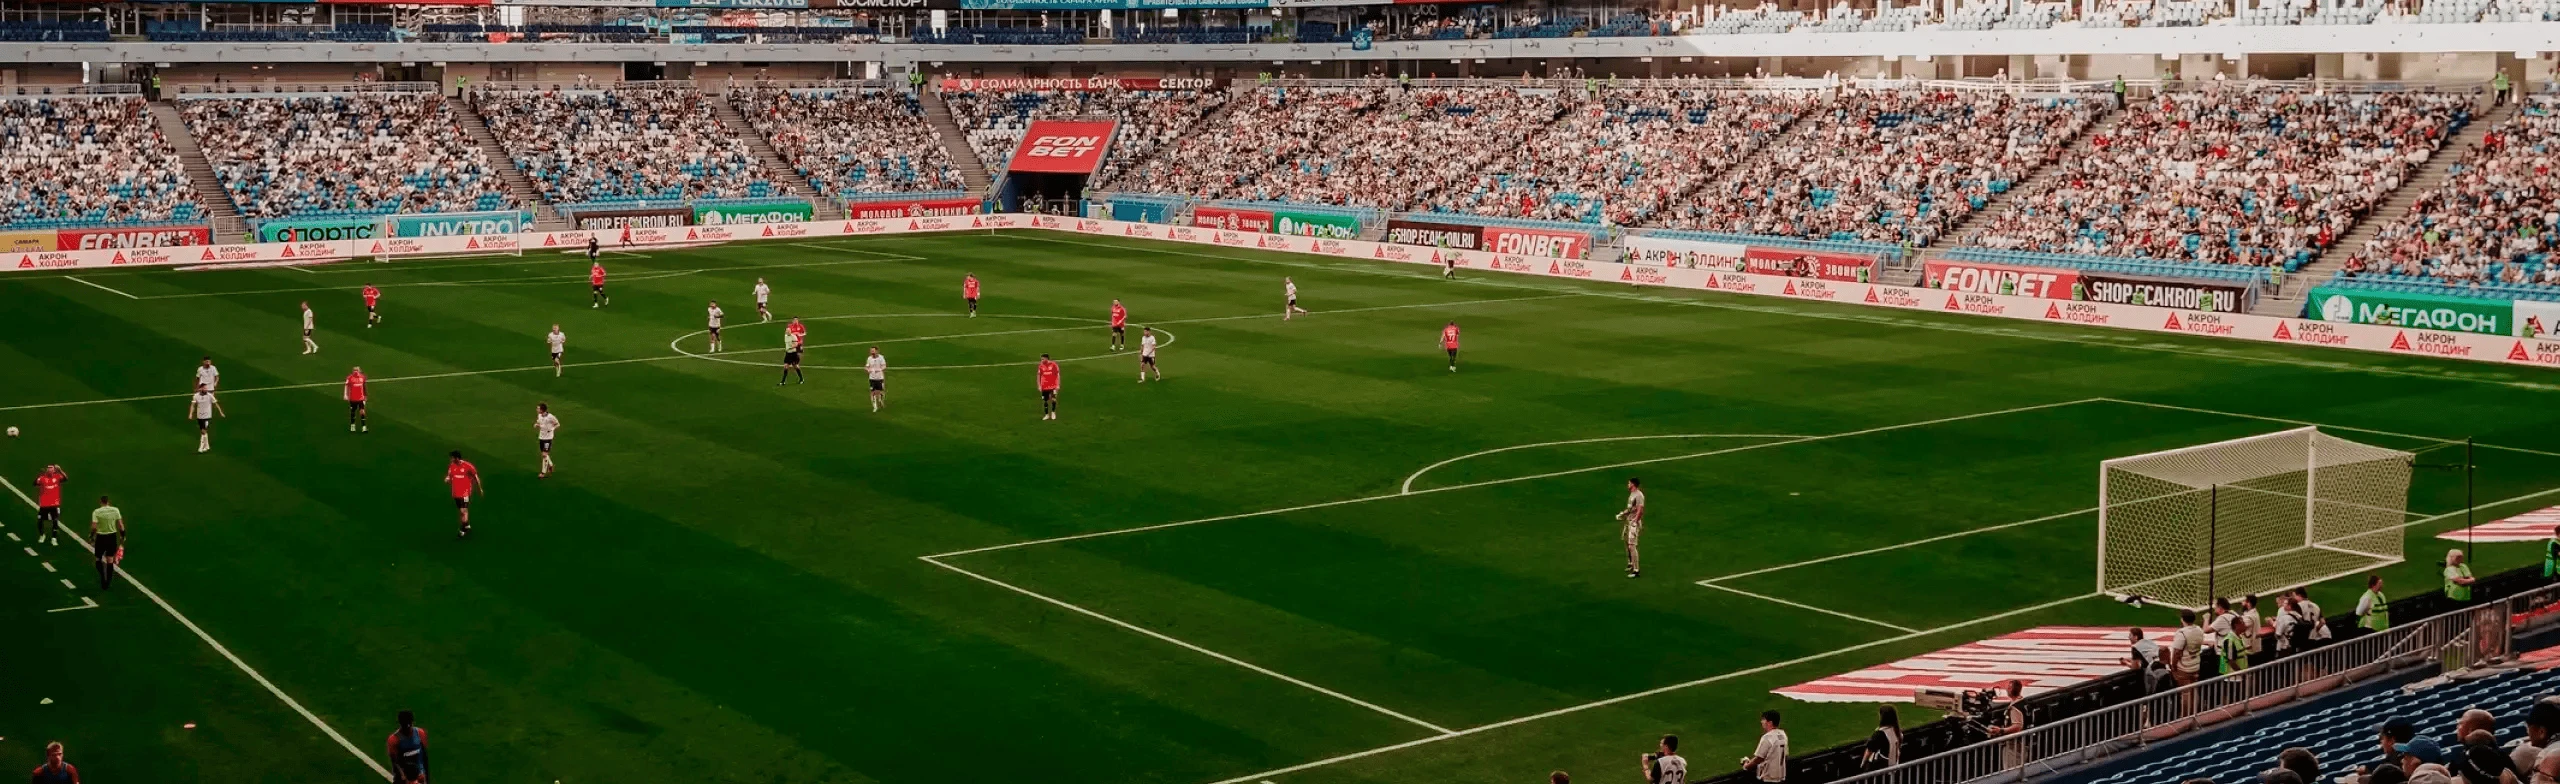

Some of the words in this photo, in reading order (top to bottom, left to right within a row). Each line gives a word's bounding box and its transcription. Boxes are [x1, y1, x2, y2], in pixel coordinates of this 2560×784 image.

[981, 78, 1082, 90] СОЛИДАРНОСТЬ
[1088, 78, 1120, 89] БАНК
[1159, 78, 1213, 89] СЕКТОР
[1034, 136, 1101, 147] FON
[1027, 147, 1096, 158] BET
[725, 212, 804, 225] МЕГАФОН
[635, 234, 667, 242] ХОЛДИНГ
[388, 245, 424, 253] ХОЛДИНГ
[131, 256, 170, 264] ХОЛДИНГ
[220, 252, 258, 260] ХОЛДИНГ
[39, 258, 79, 267] ХОЛДИНГ
[1504, 262, 1531, 272] ХОЛДИНГ
[1564, 267, 1592, 277] ХОЛДИНГ
[1636, 267, 1658, 275] АКРОН
[1636, 274, 1666, 284] ХОЛДИНГ
[1723, 274, 1747, 283] АКРОН
[1723, 282, 1755, 292] ХОЛДИНГ
[1800, 281, 1826, 289] АКРОН
[1800, 288, 1836, 299] ХОЛДИНГ
[1883, 288, 1909, 297] АКРОН
[1883, 296, 1920, 306] ХОЛДИНГ
[1964, 295, 1993, 304] АКРОН
[1964, 302, 2005, 314] ХОЛДИНГ
[2066, 303, 2096, 313] АКРОН
[2066, 312, 2109, 323] ХОЛДИНГ
[2188, 313, 2220, 323] АКРОН
[2188, 323, 2235, 335] ХОЛДИНГ
[2299, 322, 2334, 333] АКРОН
[2299, 332, 2349, 344] ХОЛДИНГ
[2417, 332, 2456, 344] АКРОН
[2417, 343, 2471, 356] ХОЛДИНГ
